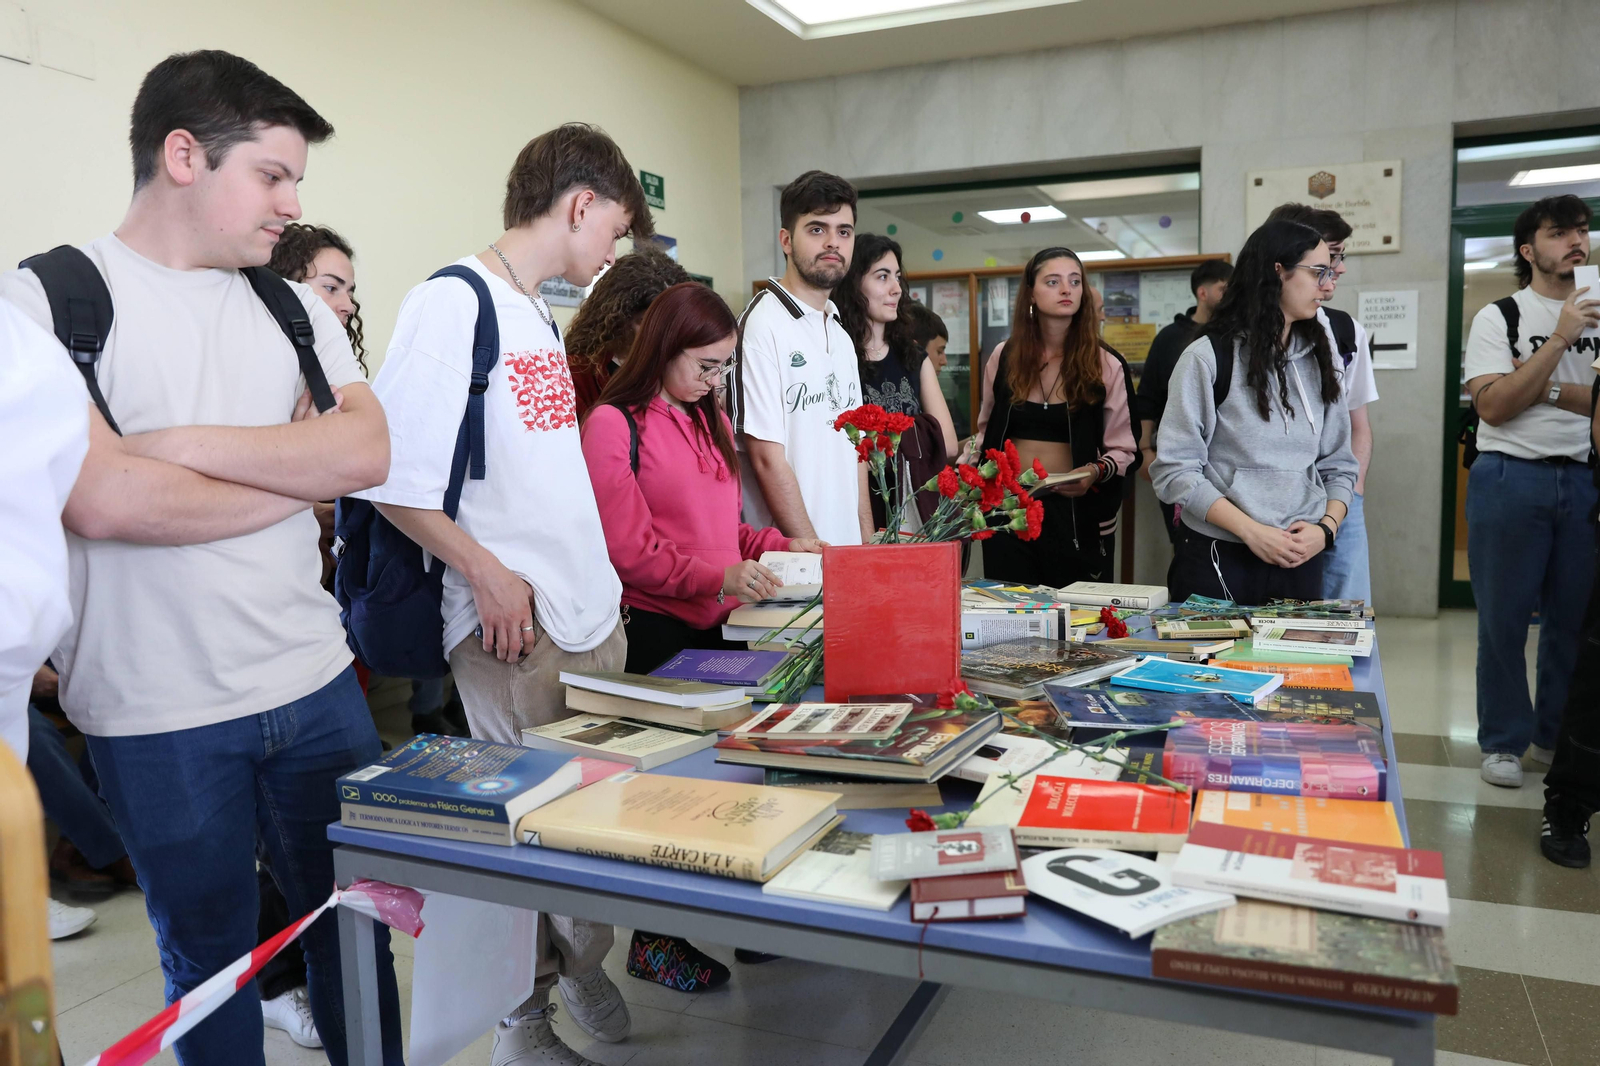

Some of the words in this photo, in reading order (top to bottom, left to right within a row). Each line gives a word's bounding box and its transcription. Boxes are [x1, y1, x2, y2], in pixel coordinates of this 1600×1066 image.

[1231, 722, 1246, 757] DEFORMANTES
[1208, 773, 1294, 790] DEFORMANTES
[1294, 781, 1344, 794] ESPEJOS
[372, 792, 397, 803] 1000
[399, 799, 428, 809] problemas
[437, 801, 459, 812] Física
[460, 805, 495, 817] General
[359, 813, 398, 825] TERMODINAMICA
[421, 821, 444, 830] MOTORES
[444, 824, 469, 833] TERMICOS
[651, 843, 699, 864] CARTE
[703, 852, 722, 867] LA
[725, 854, 735, 868] A
